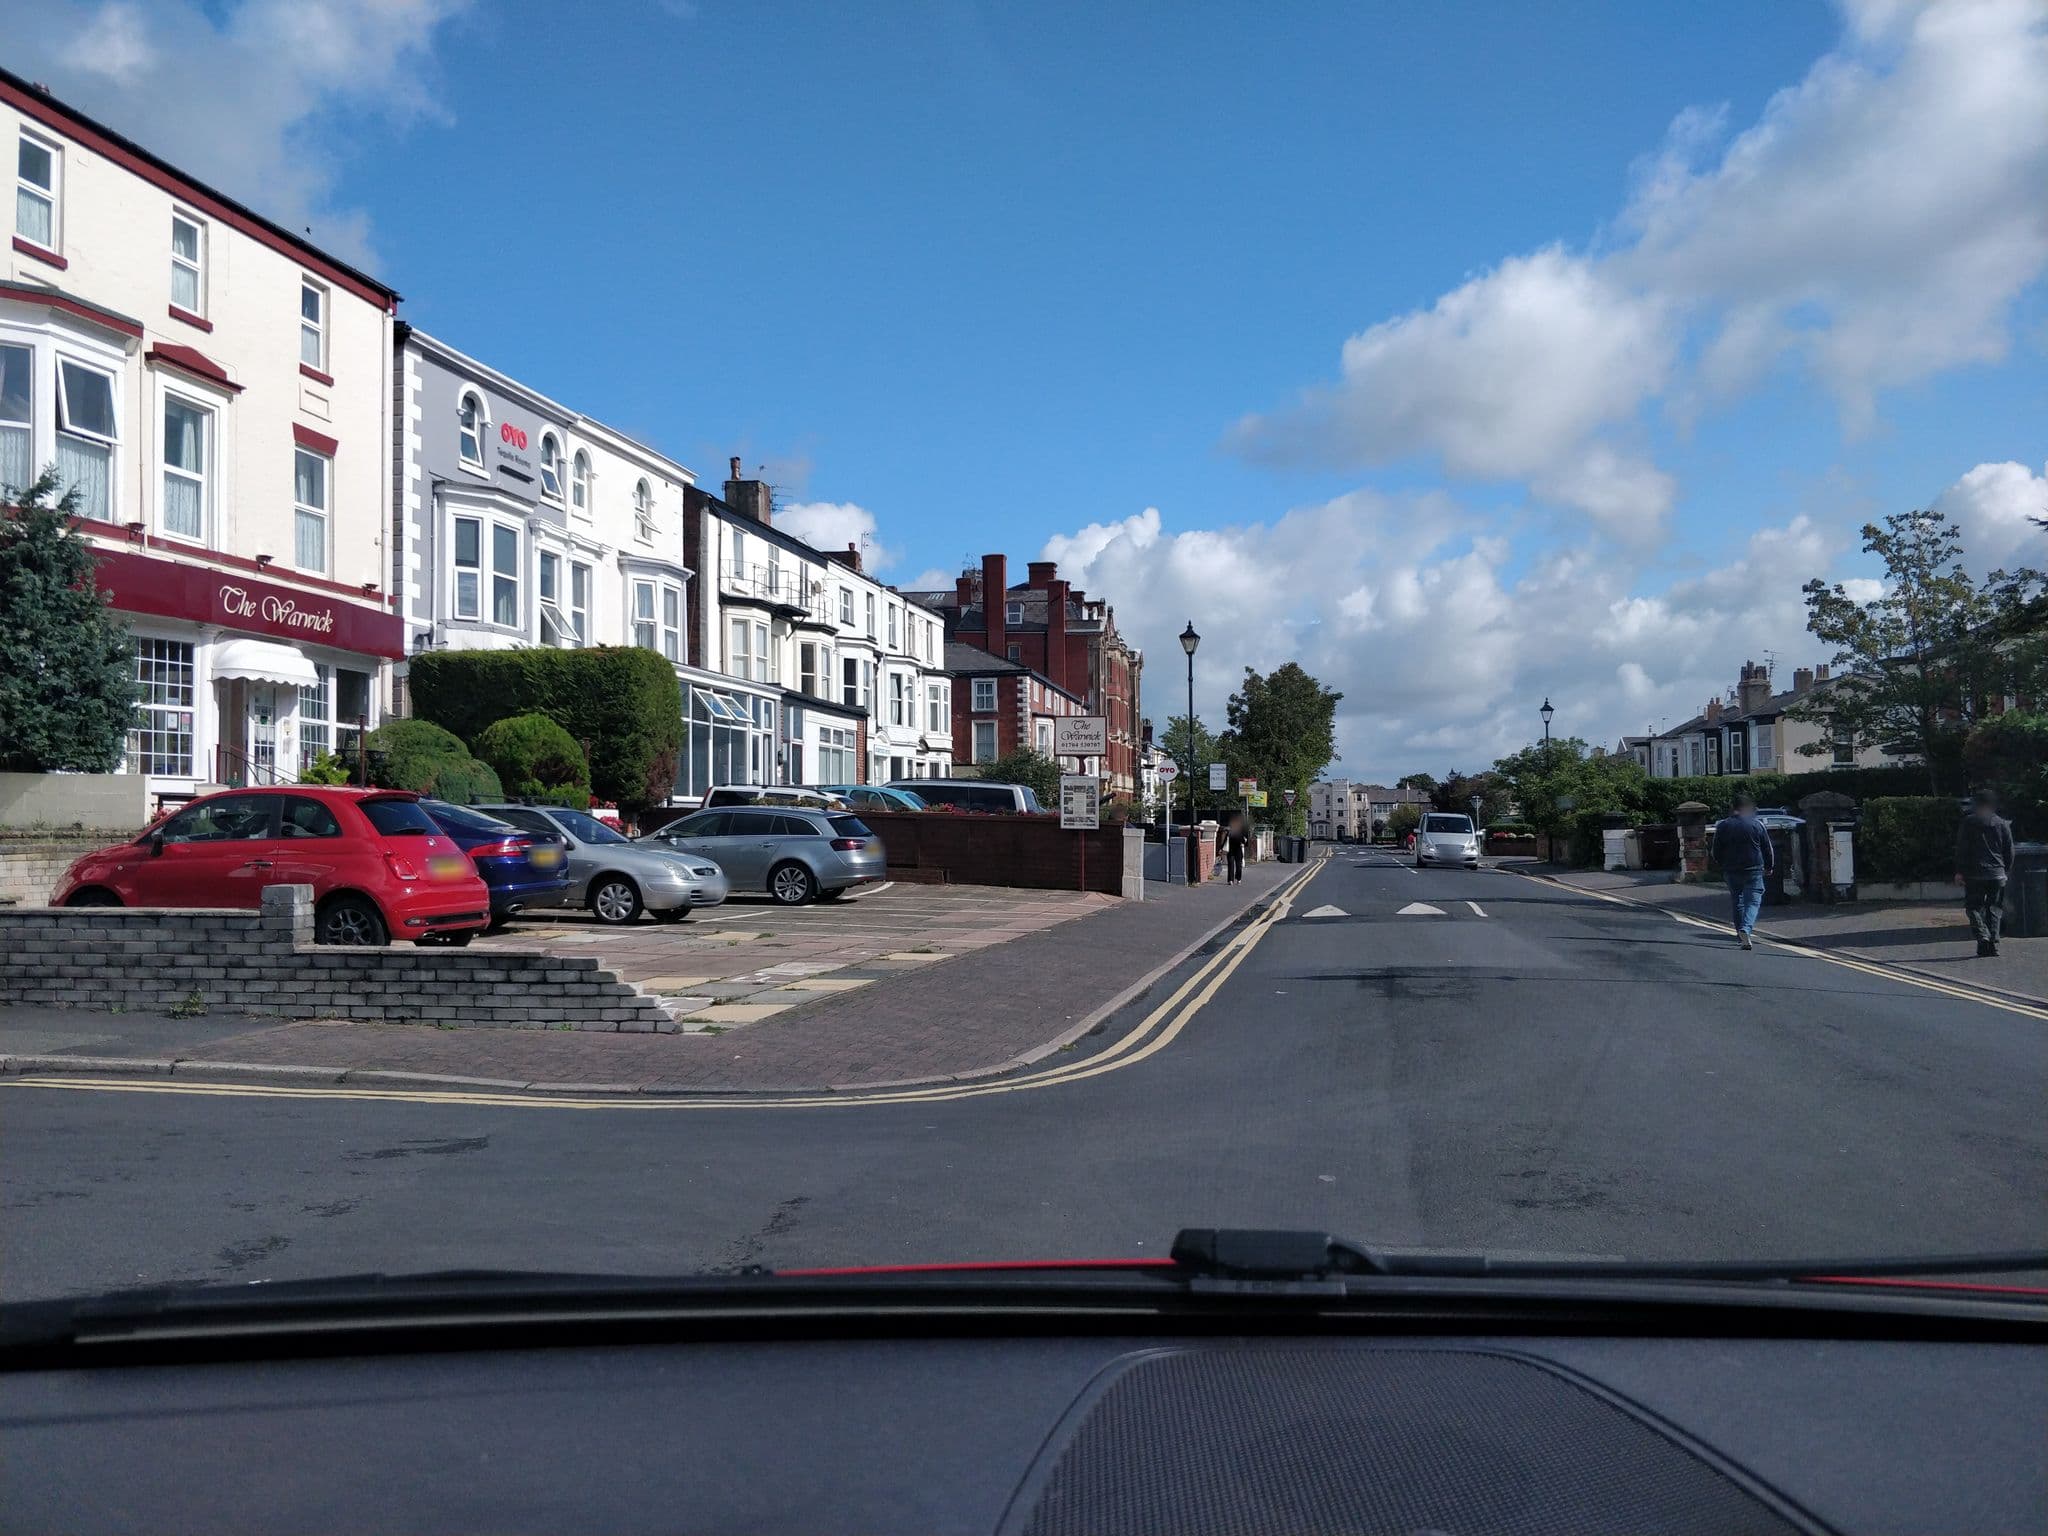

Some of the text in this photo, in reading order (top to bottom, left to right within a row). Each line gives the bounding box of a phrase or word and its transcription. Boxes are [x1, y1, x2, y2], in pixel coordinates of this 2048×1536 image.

[500, 422, 528, 451] OYO
[219, 585, 334, 633] The Warwick
[1071, 719, 1091, 730] The
[1060, 730, 1101, 741] Warwick
